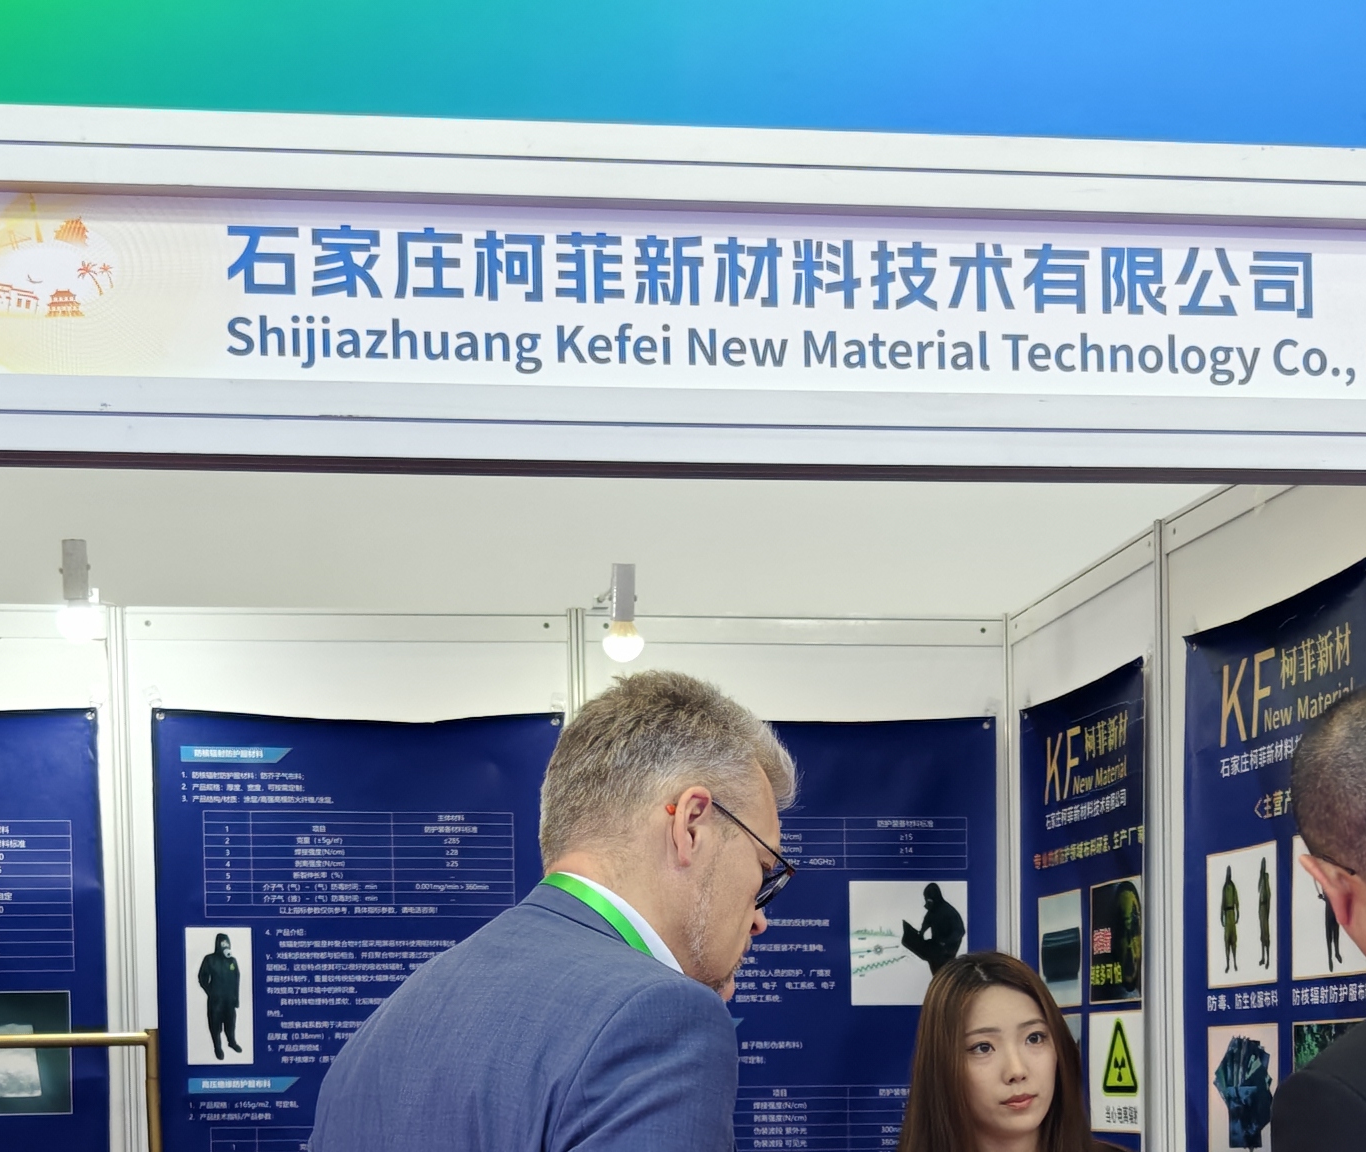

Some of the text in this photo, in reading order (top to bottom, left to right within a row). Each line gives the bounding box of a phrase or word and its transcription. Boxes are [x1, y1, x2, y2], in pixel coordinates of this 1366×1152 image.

[226, 224, 1314, 319] 石家庄柯菲新材料技术有限公司
[226, 315, 543, 373] Shijiazhuang
[556, 321, 672, 367] Kefei
[687, 326, 788, 367] New
[803, 328, 990, 372] Material
[1001, 331, 1261, 387] Technology
[1272, 338, 1356, 388] Co.,
[1279, 621, 1352, 691] 柯菲新材
[1220, 647, 1276, 748] KF
[1263, 705, 1293, 733] New
[1044, 725, 1081, 806] KF
[1084, 710, 1129, 762] 柯菲新材
[1072, 754, 1128, 796] New Material
